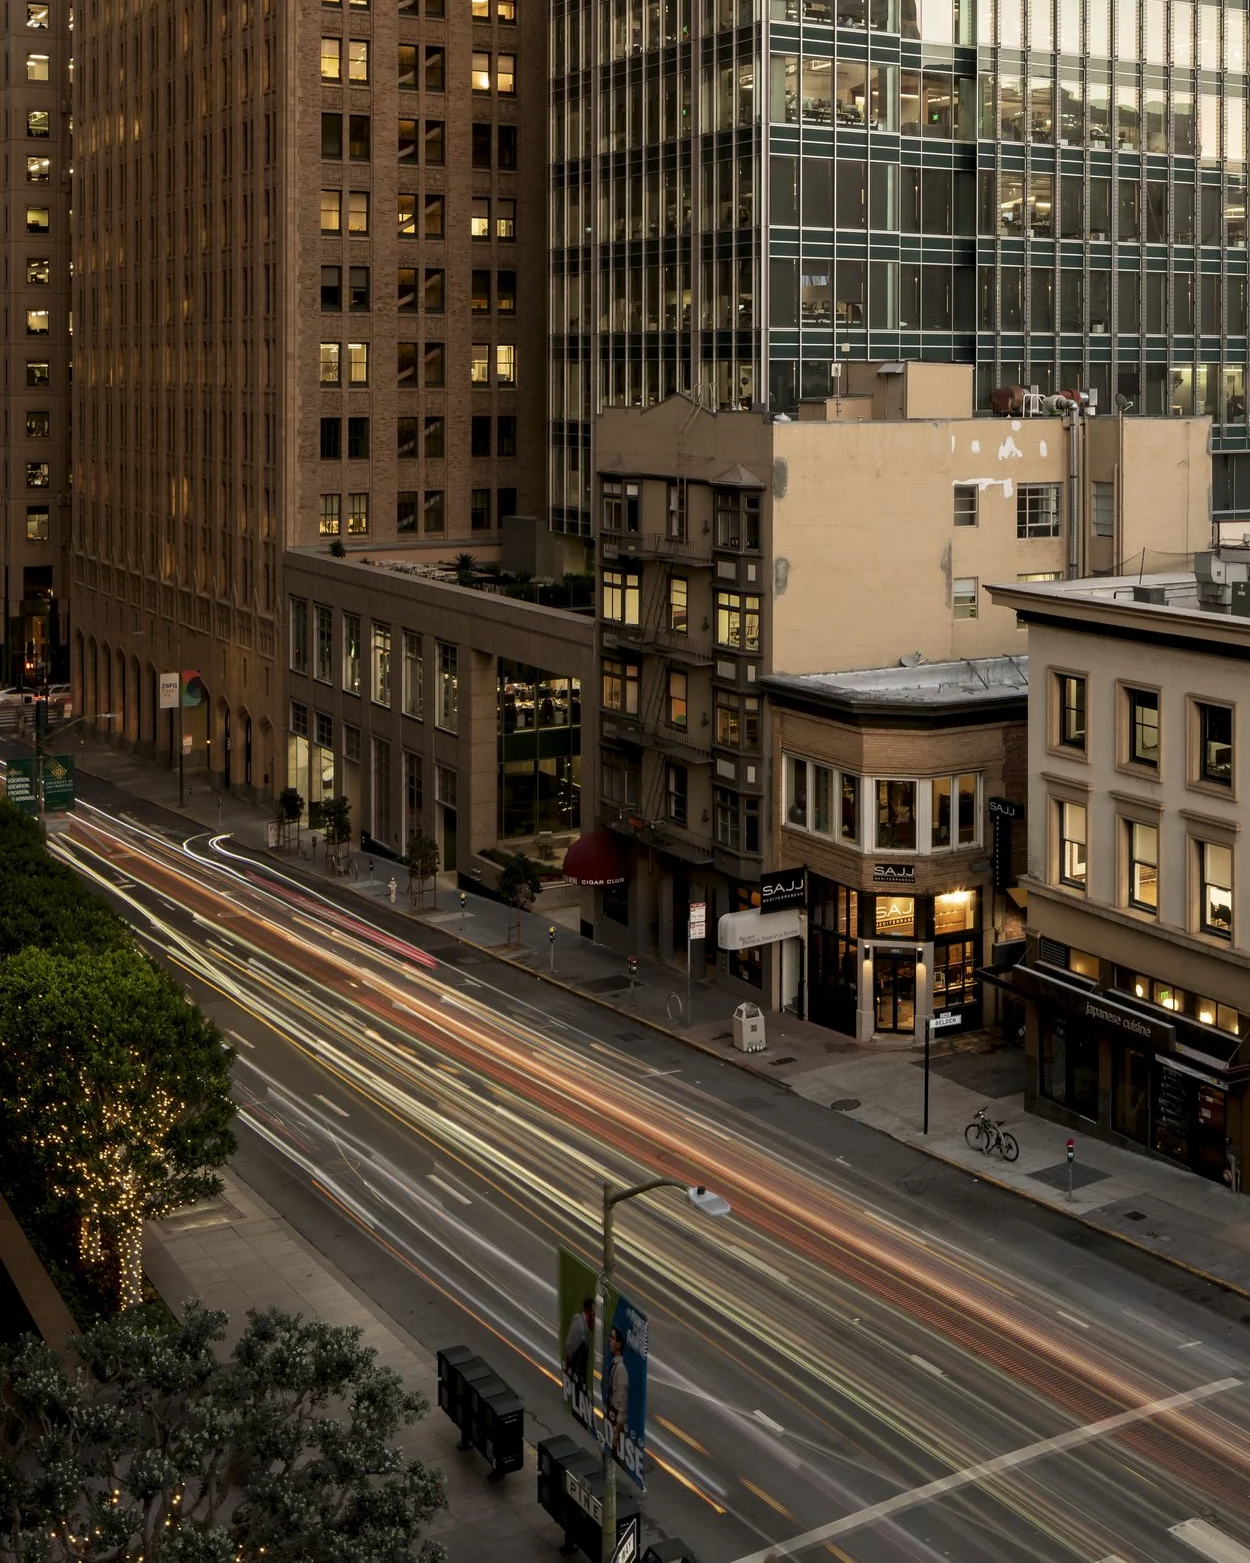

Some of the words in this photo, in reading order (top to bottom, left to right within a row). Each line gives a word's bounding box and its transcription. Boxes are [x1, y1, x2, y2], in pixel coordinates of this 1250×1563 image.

[990, 801, 1016, 816] SAJJ
[874, 866, 914, 876] SAJJ
[606, 877, 625, 885] CLUB
[762, 878, 804, 896] SAJJ
[875, 901, 913, 918] SAJ
[1085, 1001, 1121, 1025] japanese
[1122, 1019, 1151, 1037] cuisine
[571, 1481, 599, 1521] PINE
